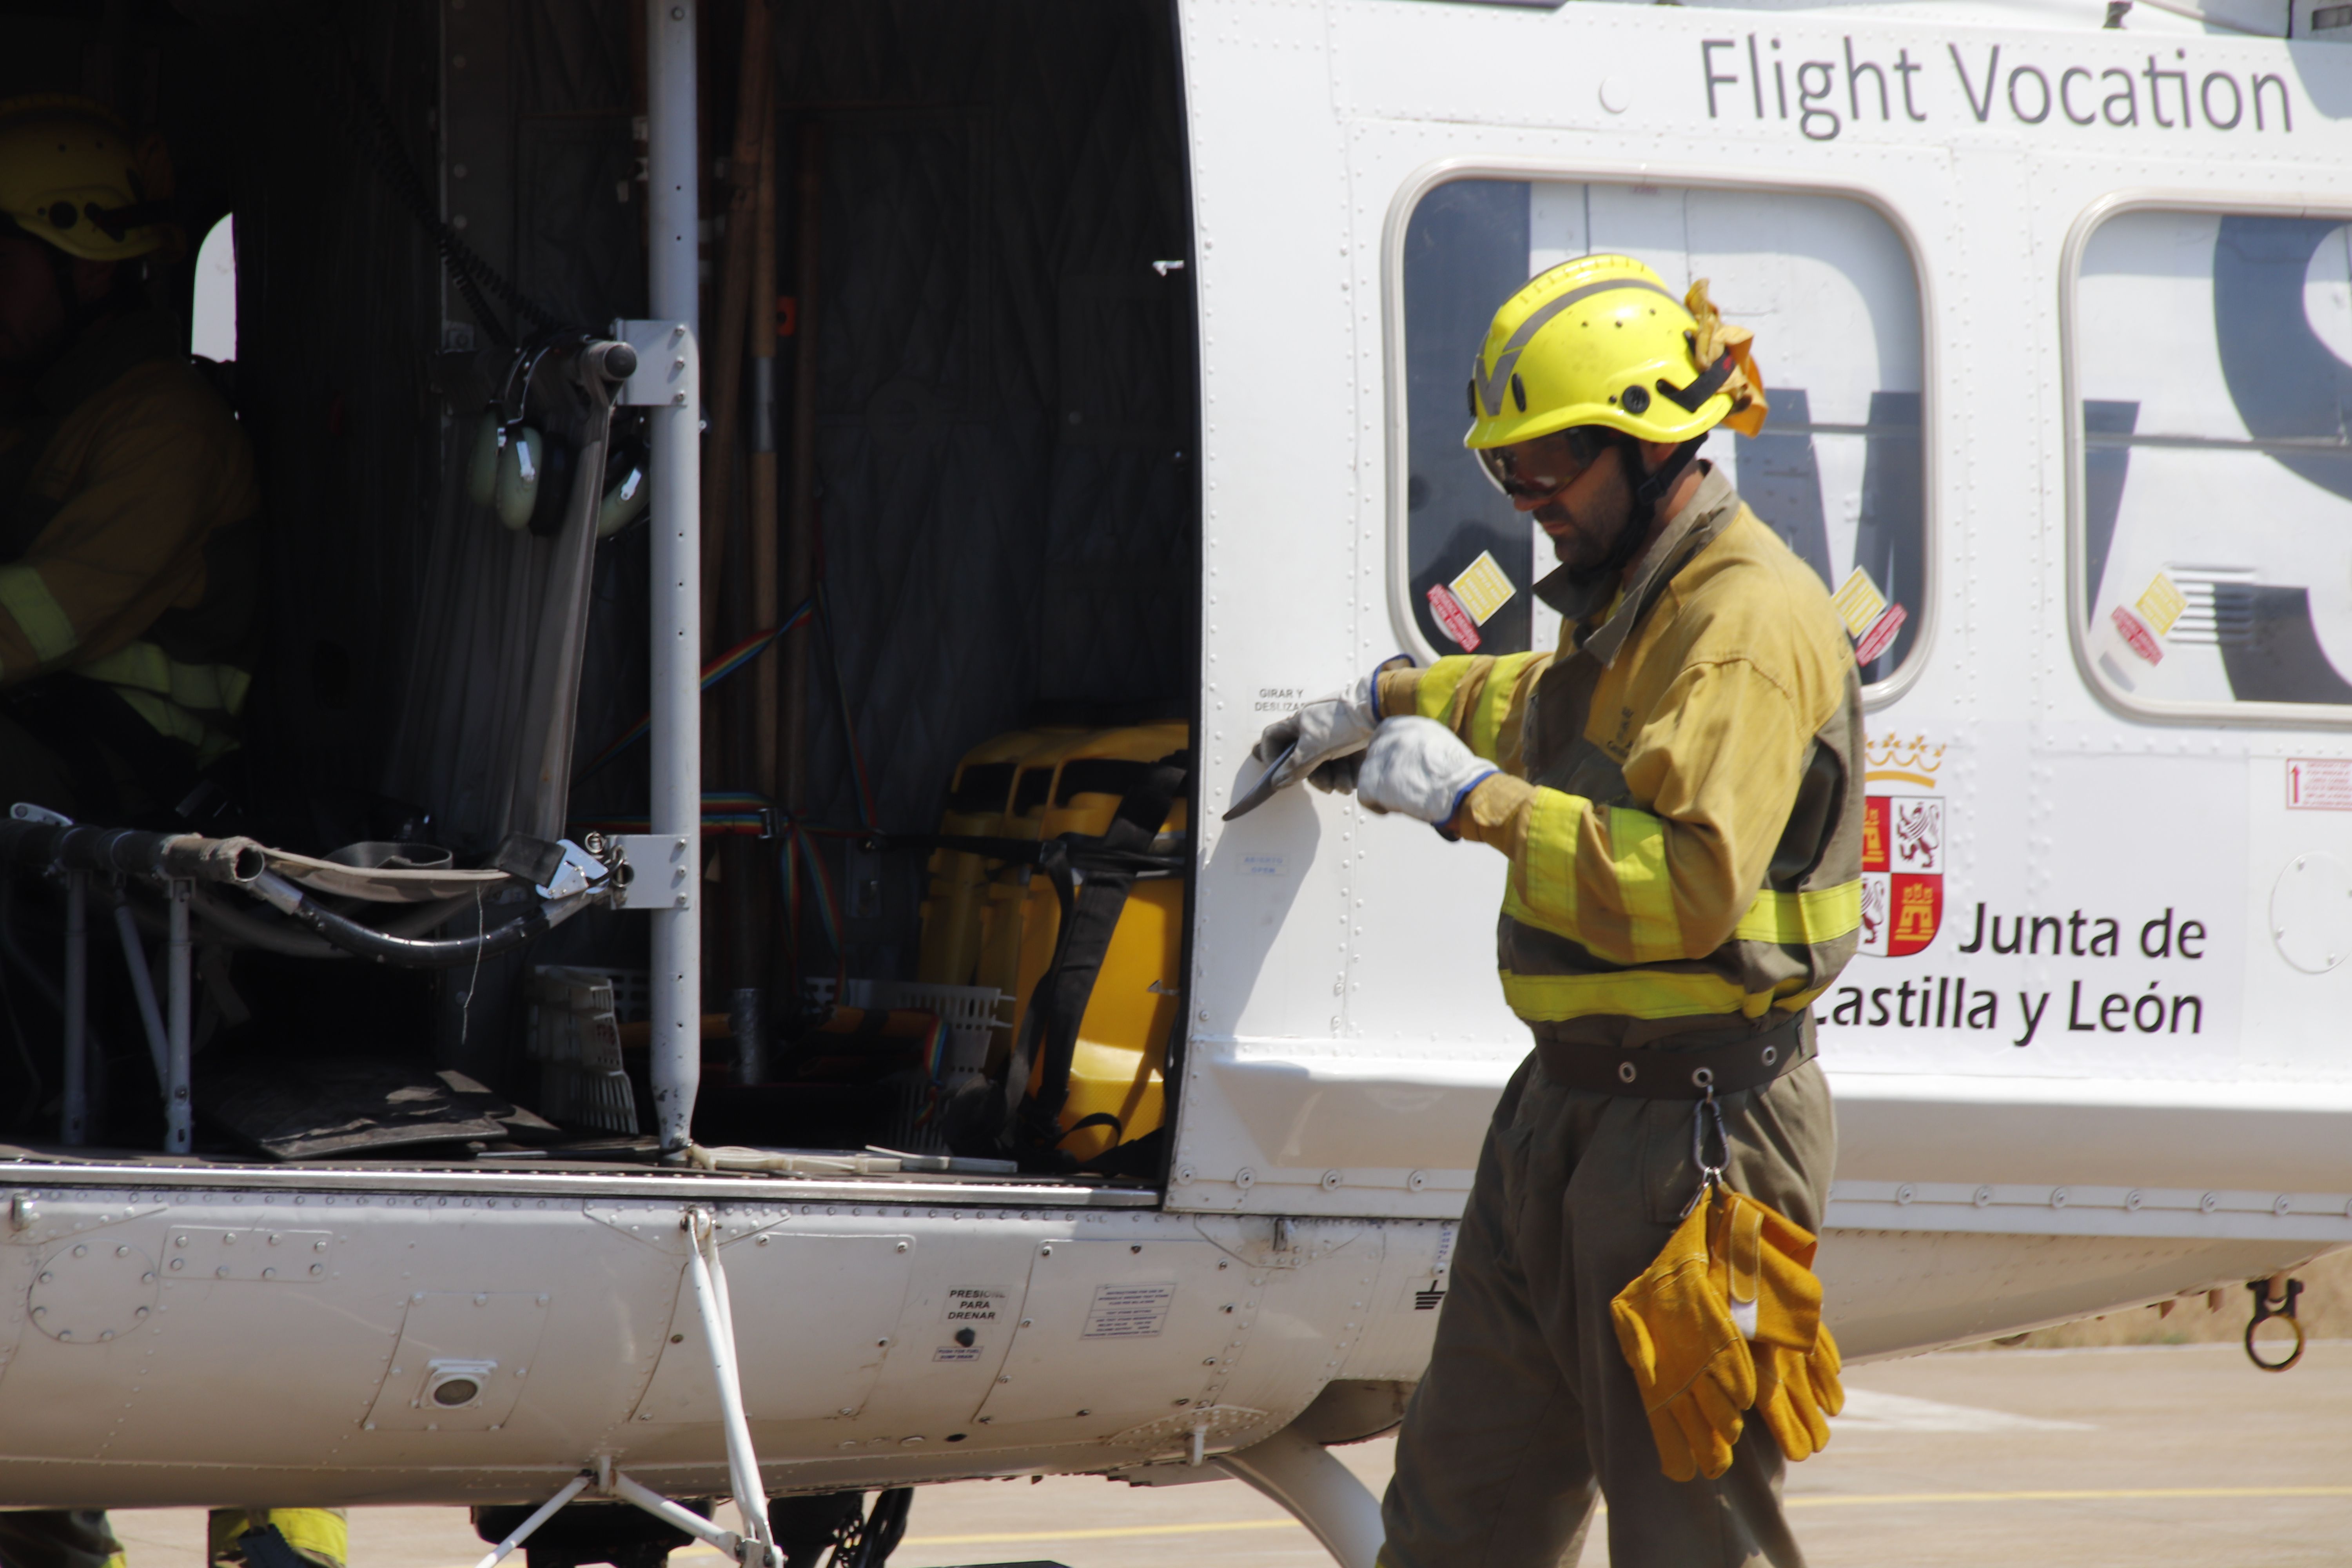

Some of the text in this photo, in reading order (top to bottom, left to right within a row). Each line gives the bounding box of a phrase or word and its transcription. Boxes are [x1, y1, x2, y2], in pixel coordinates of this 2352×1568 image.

[1701, 34, 2293, 142] Flight Vocation
[1259, 689, 1304, 698] GIRAR Y
[1959, 902, 2206, 959] Junta de
[1815, 976, 2202, 1047] astilla y León
[947, 1311, 996, 1320] DRENAR
[959, 1301, 990, 1309] PARA
